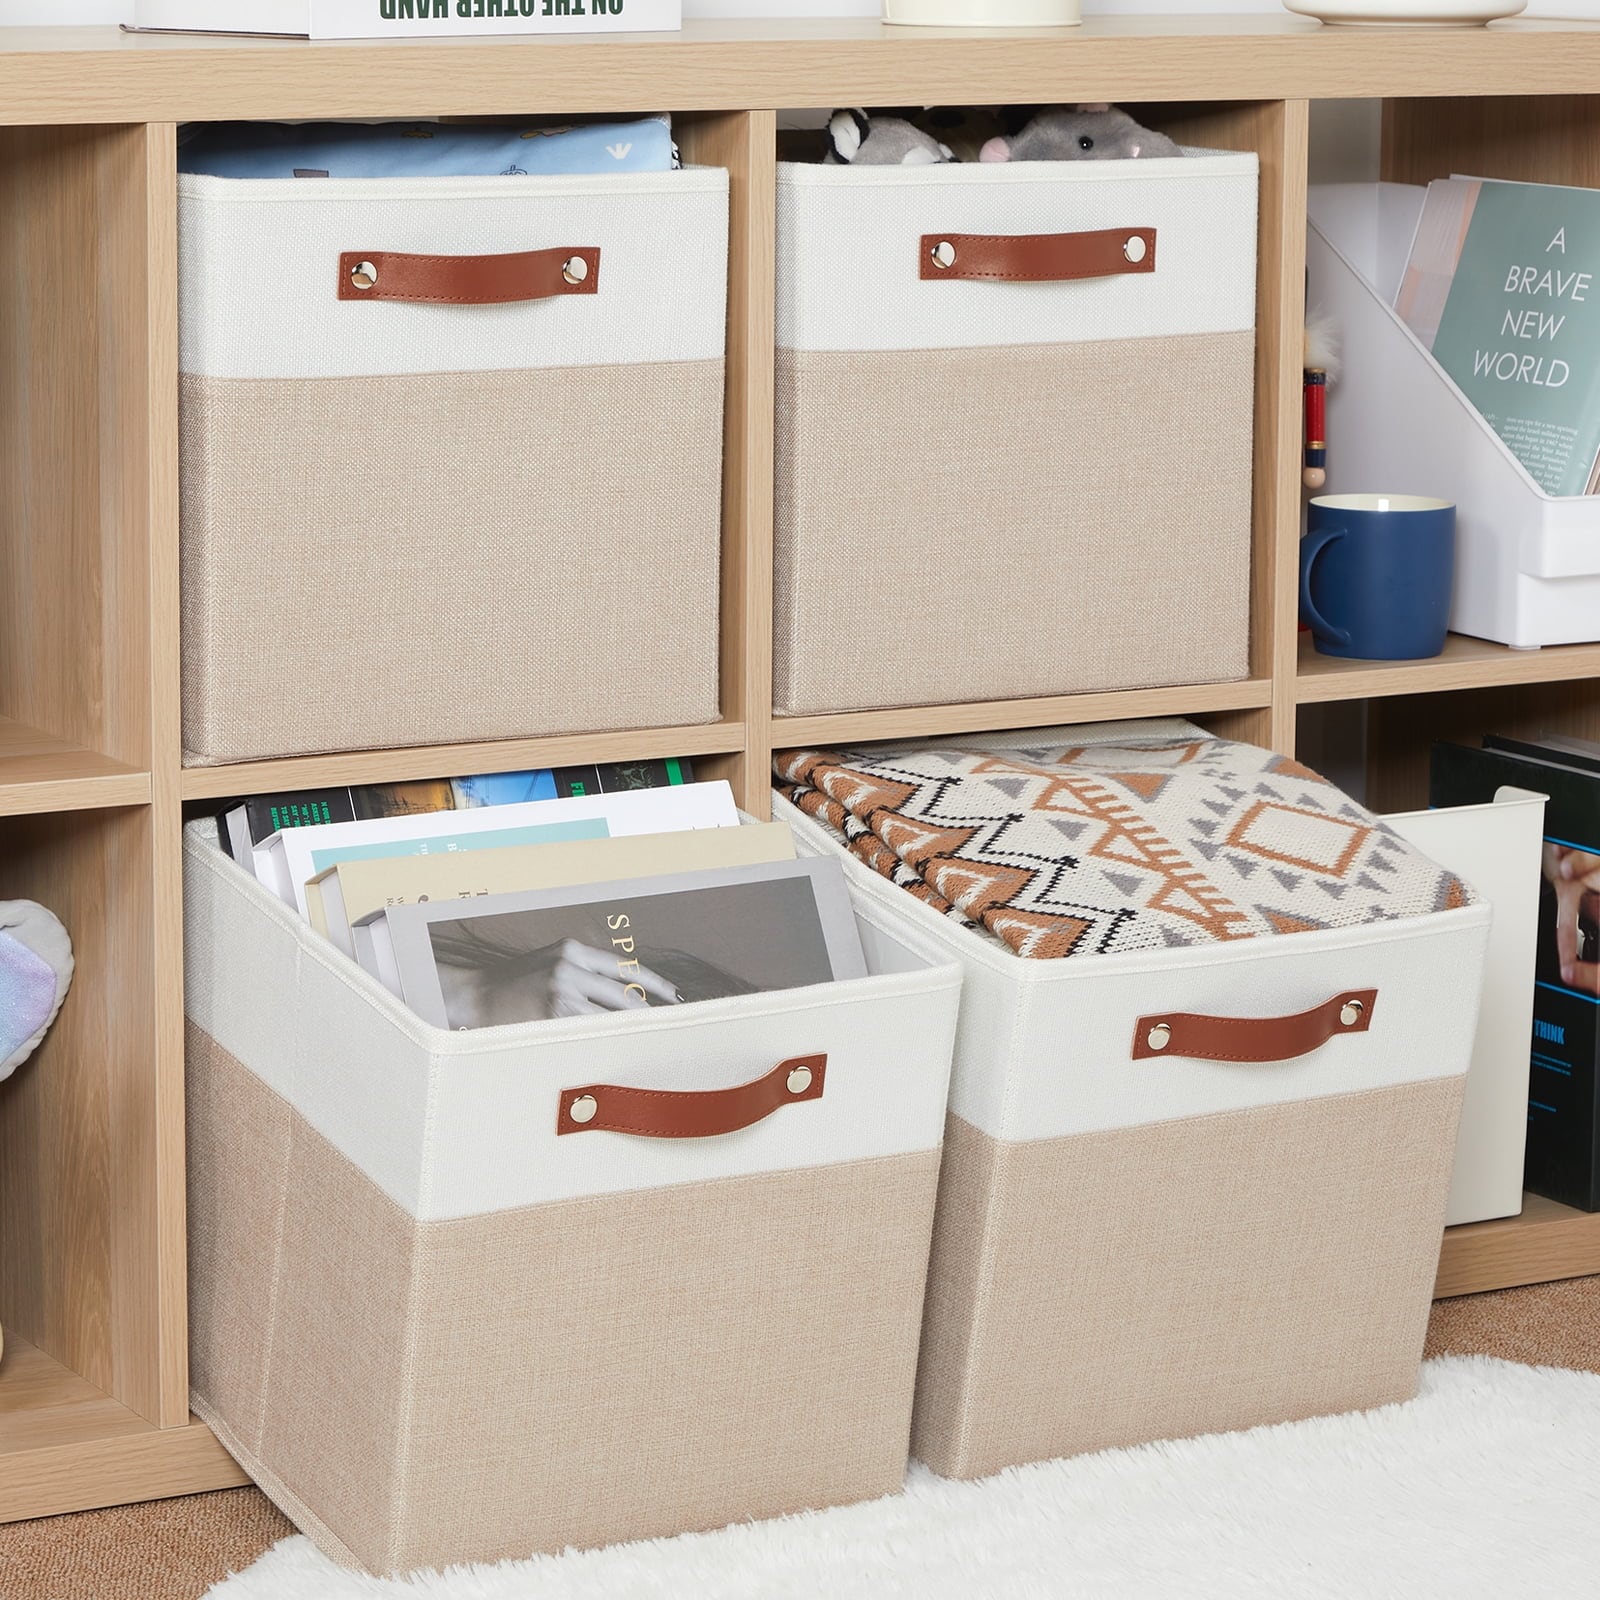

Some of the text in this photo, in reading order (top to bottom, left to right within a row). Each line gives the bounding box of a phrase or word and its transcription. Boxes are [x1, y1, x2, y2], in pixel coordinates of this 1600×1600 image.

[379, 0, 624, 19] ON THE OTHER HAND
[1546, 226, 1566, 254] A
[1504, 265, 1593, 302] BRAVE
[1500, 309, 1566, 341] NEW
[1473, 349, 1571, 388] WORLD
[1534, 1018, 1565, 1045] THINK
